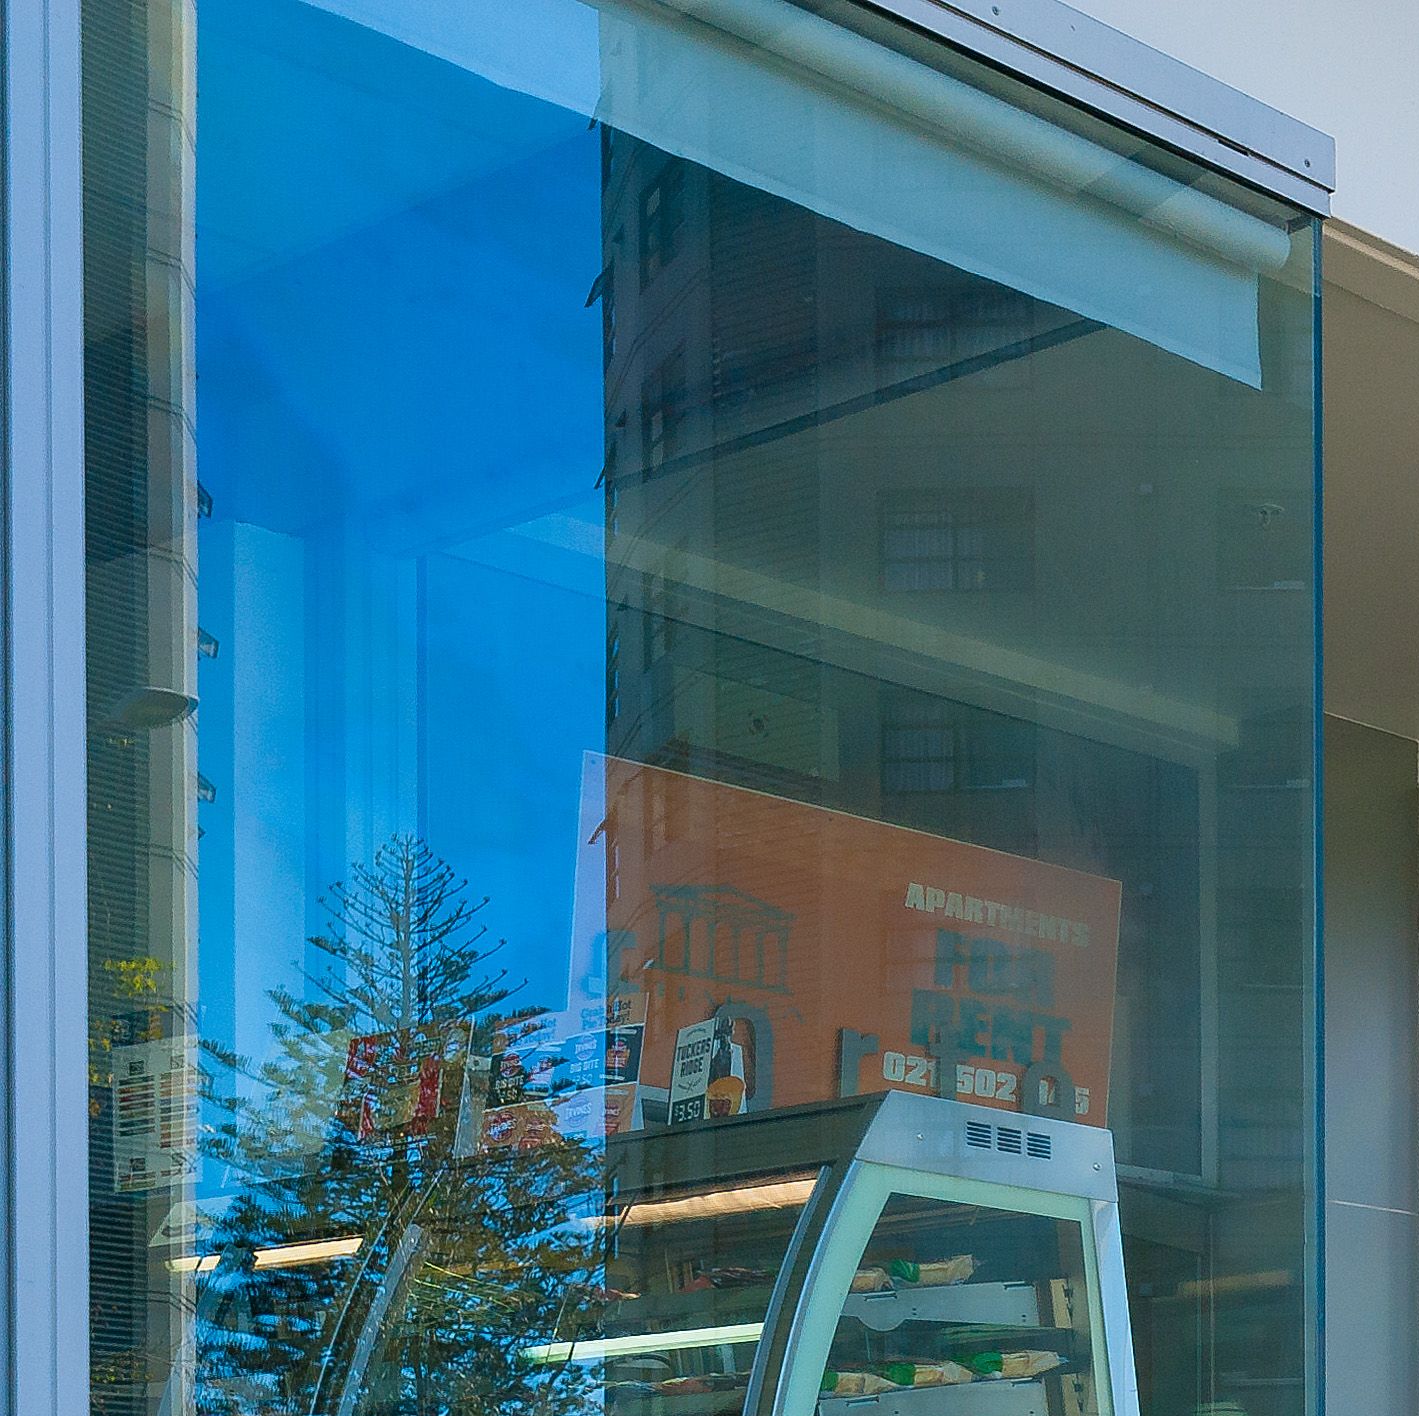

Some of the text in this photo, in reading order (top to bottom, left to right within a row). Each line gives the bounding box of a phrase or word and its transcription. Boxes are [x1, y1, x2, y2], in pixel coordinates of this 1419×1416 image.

[904, 881, 1090, 948] APARTMENTS
[676, 1037, 712, 1062] TUCKERS
[955, 1063, 1018, 1102] 502
